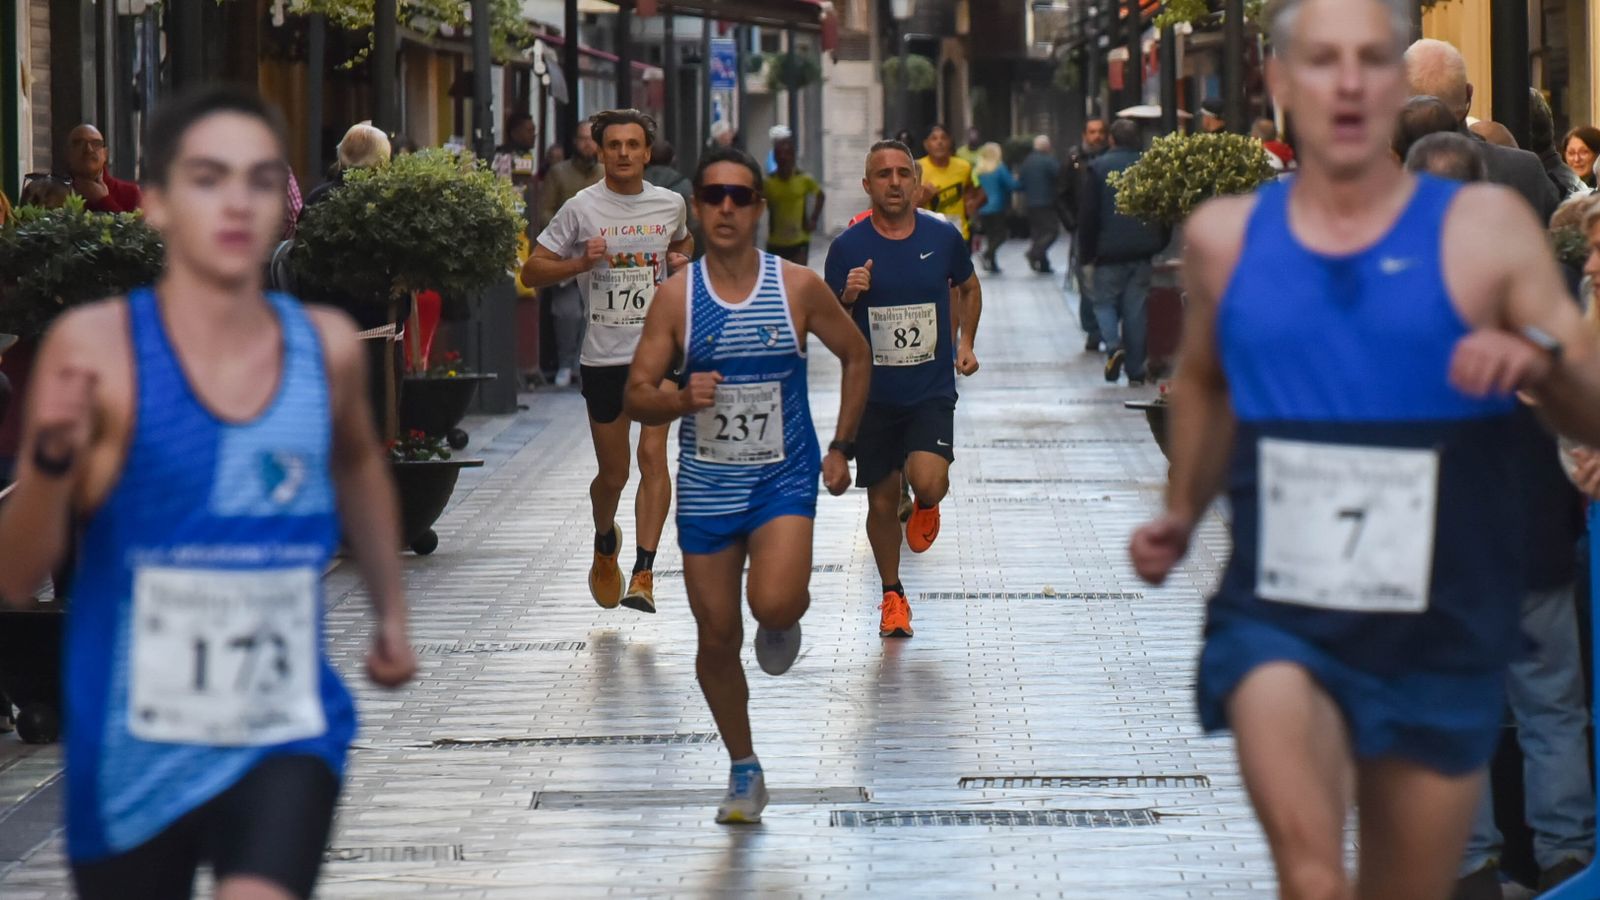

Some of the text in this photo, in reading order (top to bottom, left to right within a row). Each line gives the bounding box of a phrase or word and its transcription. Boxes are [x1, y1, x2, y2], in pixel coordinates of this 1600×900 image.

[600, 224, 667, 236] VIII CARRERA
[606, 289, 645, 310] 176
[894, 326, 921, 348] 82
[713, 413, 769, 441] 237
[1335, 505, 1368, 560] 7
[193, 633, 290, 693] 173
